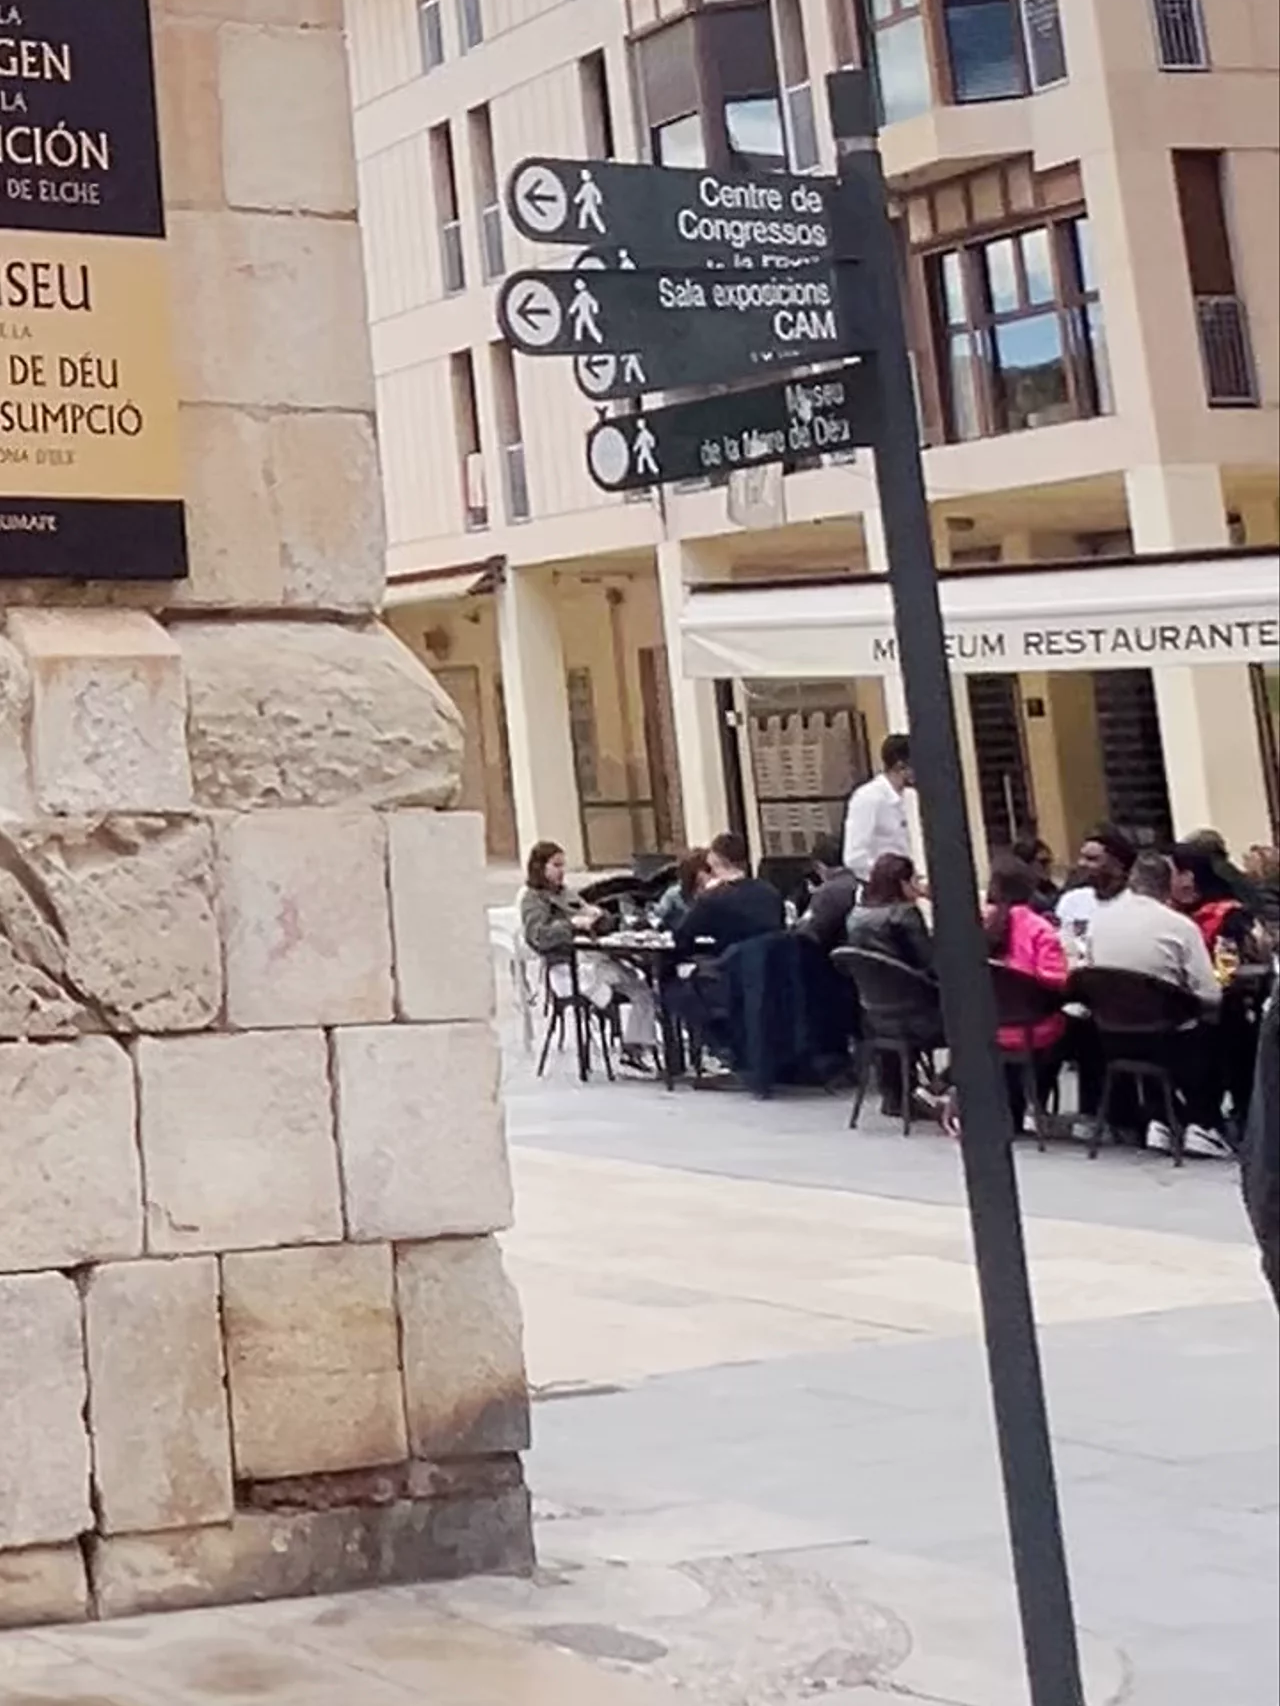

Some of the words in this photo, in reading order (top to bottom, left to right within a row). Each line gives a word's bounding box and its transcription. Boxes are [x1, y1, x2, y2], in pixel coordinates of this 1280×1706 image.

[0, 89, 28, 112] LA
[6, 178, 33, 201] DE
[39, 180, 101, 205] ELCHE
[698, 176, 783, 212] Centre
[790, 184, 824, 214] de
[677, 208, 828, 249] Congressos
[658, 276, 707, 308] Sala
[712, 276, 832, 312] exposicions
[773, 309, 838, 342] CAM
[9, 353, 47, 388] DE
[58, 351, 119, 389] DÉU
[872, 632, 1007, 663] MEUM
[1023, 619, 1280, 656] RESTAURANTE
